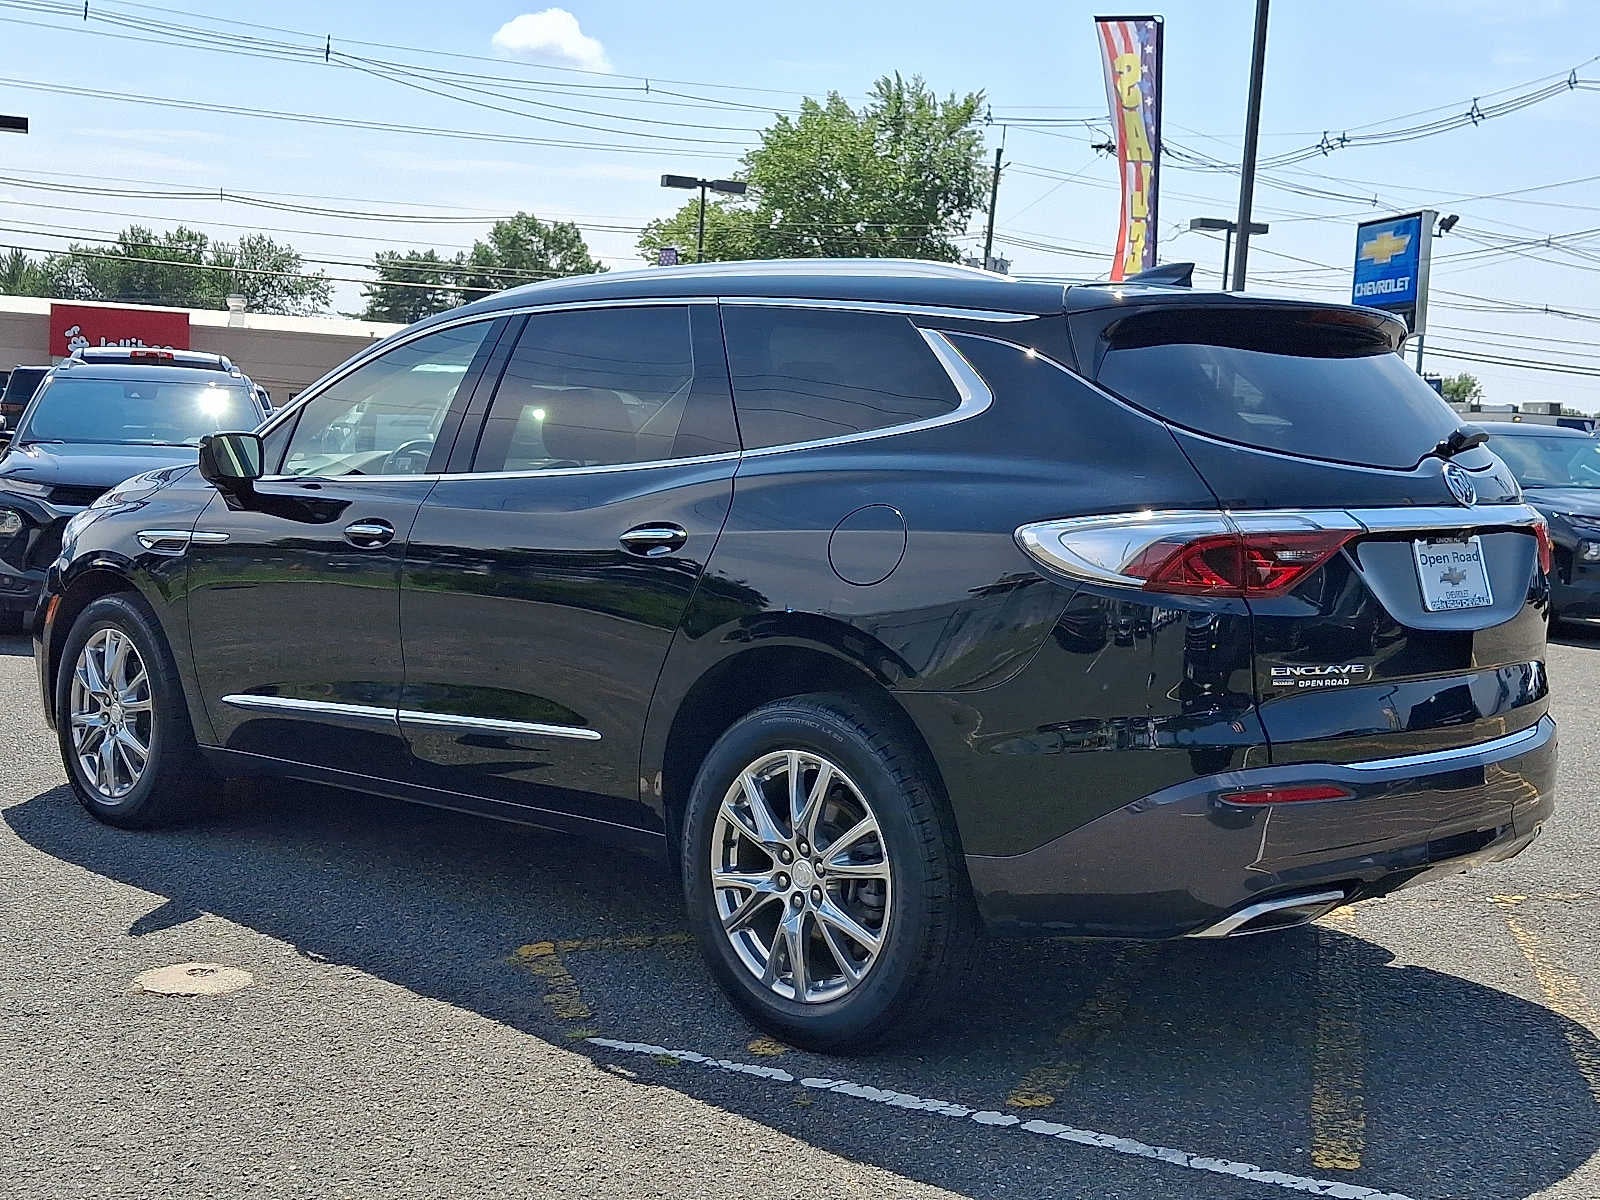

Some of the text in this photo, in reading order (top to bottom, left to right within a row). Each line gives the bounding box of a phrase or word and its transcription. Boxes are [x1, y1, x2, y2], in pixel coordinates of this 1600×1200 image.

[1354, 277, 1410, 297] CHEVROLET
[1420, 552, 1480, 567] Open Road
[1271, 665, 1365, 676] ENCLAVE
